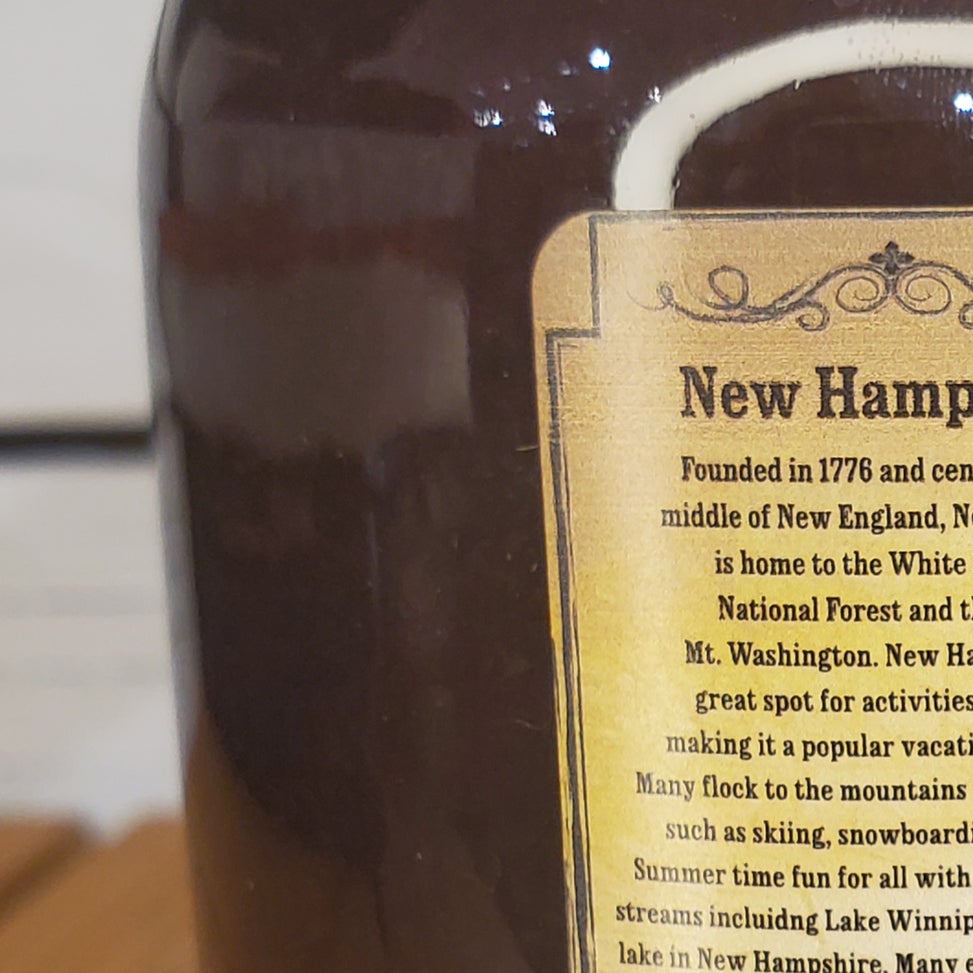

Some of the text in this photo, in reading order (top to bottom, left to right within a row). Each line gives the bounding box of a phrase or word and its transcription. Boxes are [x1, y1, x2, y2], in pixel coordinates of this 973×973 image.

[679, 365, 802, 420] New
[681, 456, 783, 483] Founded
[819, 457, 873, 483] 1776
[661, 501, 741, 529] middle
[777, 503, 832, 530] New
[838, 503, 946, 535] England,
[740, 549, 805, 576] home
[842, 550, 882, 576] the
[888, 550, 966, 576] White
[718, 594, 819, 622] National
[826, 596, 902, 622] Forest
[684, 639, 721, 665] Mt.
[727, 641, 878, 673] Washington.
[885, 643, 940, 667] New
[695, 688, 757, 715] great
[763, 691, 814, 717] spot
[820, 688, 855, 712] for
[666, 729, 752, 761] making
[801, 733, 895, 762] popular
[636, 771, 695, 802] Many
[703, 774, 759, 799] flock
[840, 777, 967, 801] mountains
[666, 817, 717, 841] such
[752, 820, 831, 850] skiing,
[634, 857, 727, 885] Summer
[732, 863, 785, 888] time
[792, 864, 831, 889] fun
[879, 865, 908, 889] all
[914, 864, 971, 889] with
[616, 902, 703, 927] streams
[710, 905, 819, 936] incluidng
[825, 908, 880, 932] Lake
[619, 941, 663, 966] lake
[697, 947, 747, 972] New
